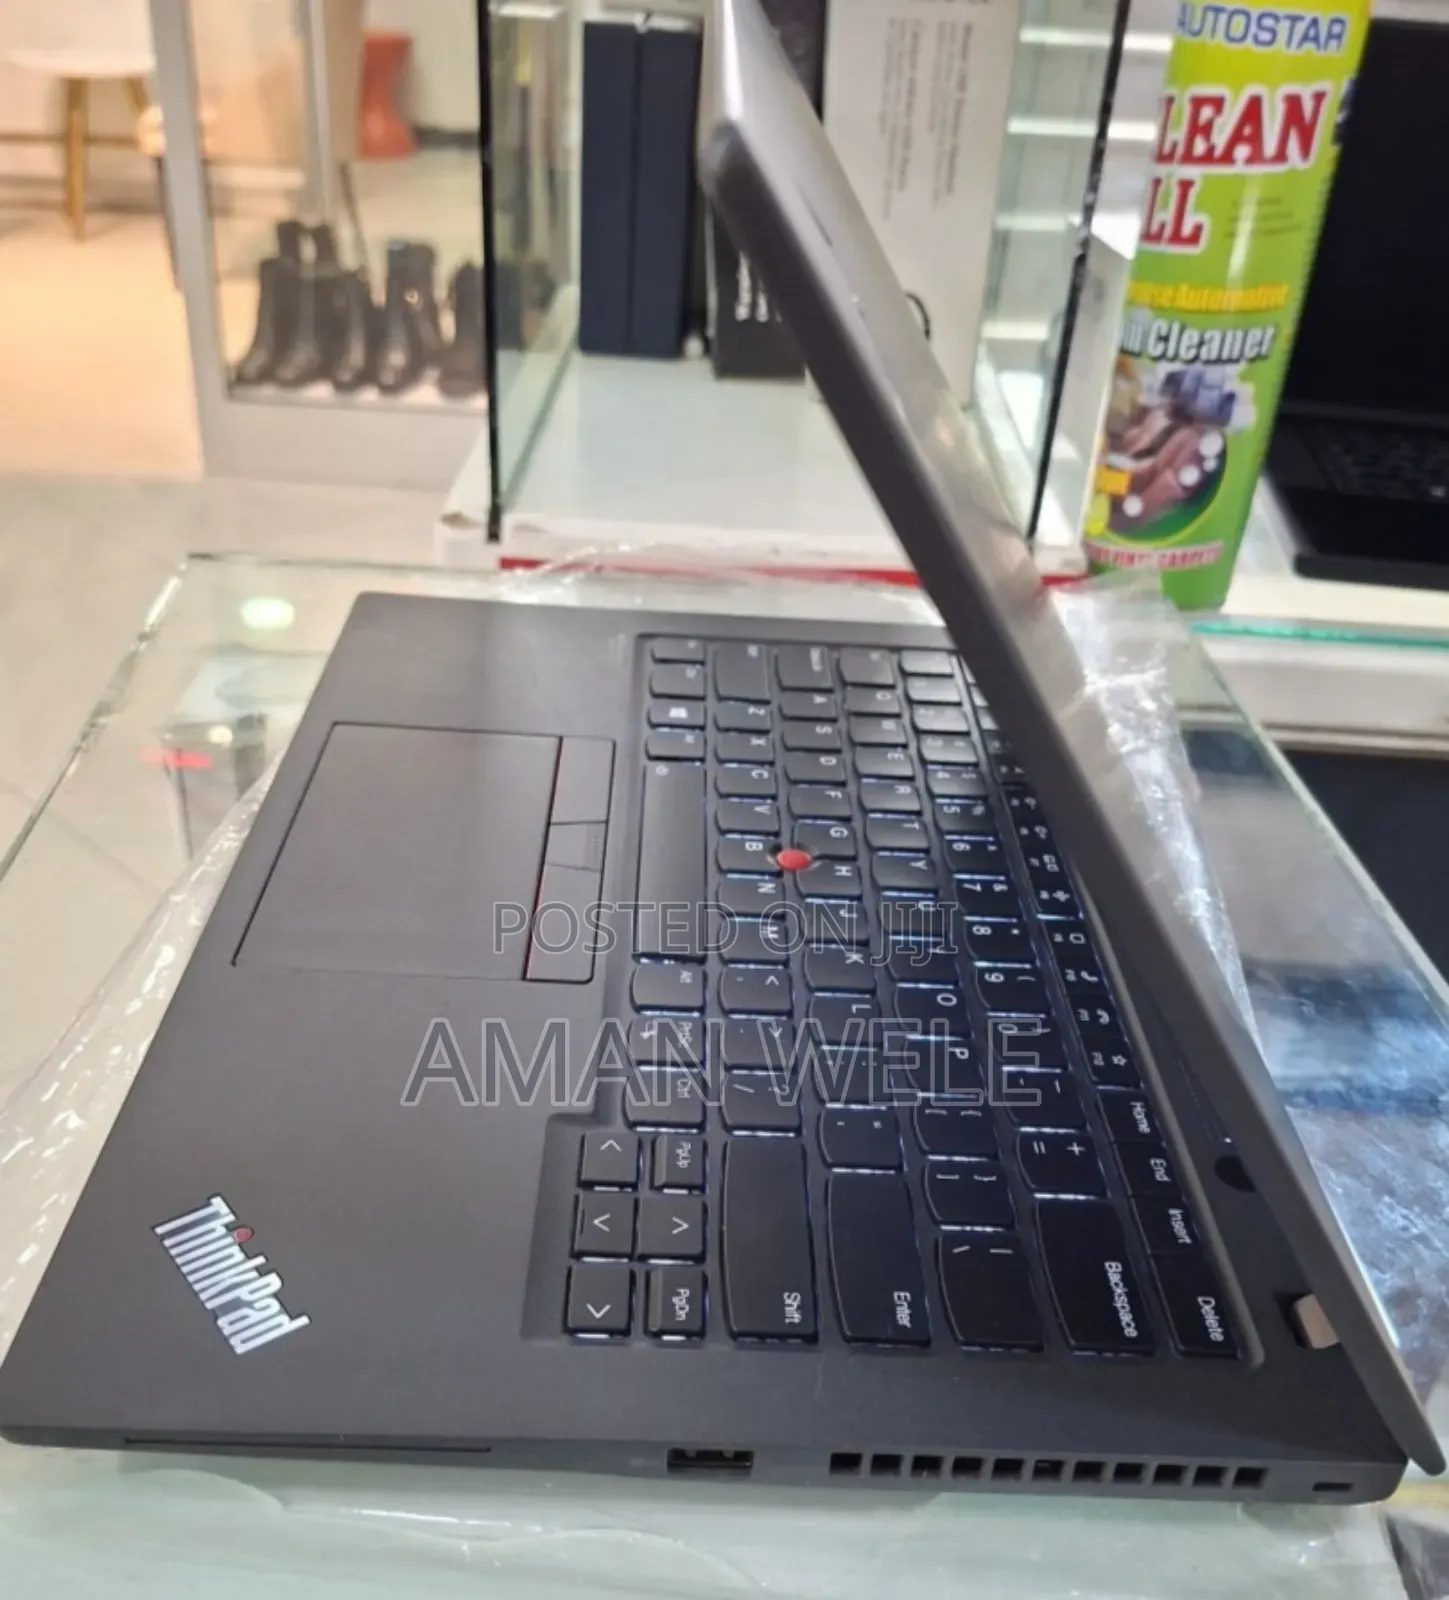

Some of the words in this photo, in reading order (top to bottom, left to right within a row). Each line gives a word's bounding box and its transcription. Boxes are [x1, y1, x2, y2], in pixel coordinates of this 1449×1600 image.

[1148, 317, 1276, 362] Cleaner
[815, 724, 833, 735] S
[751, 768, 769, 780] C
[824, 789, 842, 800] F
[753, 804, 771, 816] V
[942, 804, 961, 814] 5
[829, 826, 849, 838] G
[745, 841, 763, 852] B
[834, 865, 853, 876] H
[908, 860, 928, 870] Y
[757, 882, 776, 894] N
[963, 883, 982, 893] 7
[972, 925, 992, 935] 8
[984, 971, 1005, 983] 9
[936, 993, 957, 1007] O
[851, 1003, 871, 1015] L
[948, 1047, 969, 1059] P
[1129, 1101, 1151, 1134] Home
[676, 1141, 692, 1169] PgUp
[1150, 1158, 1171, 1182] End
[1168, 1208, 1192, 1244] Insert
[154, 1196, 311, 1355] ThinkPad
[672, 1288, 690, 1321] PgDn
[1104, 1261, 1138, 1338] Backspace
[783, 1291, 802, 1324] Shift
[893, 1291, 912, 1328] Enter
[1197, 1296, 1224, 1342] Delete
